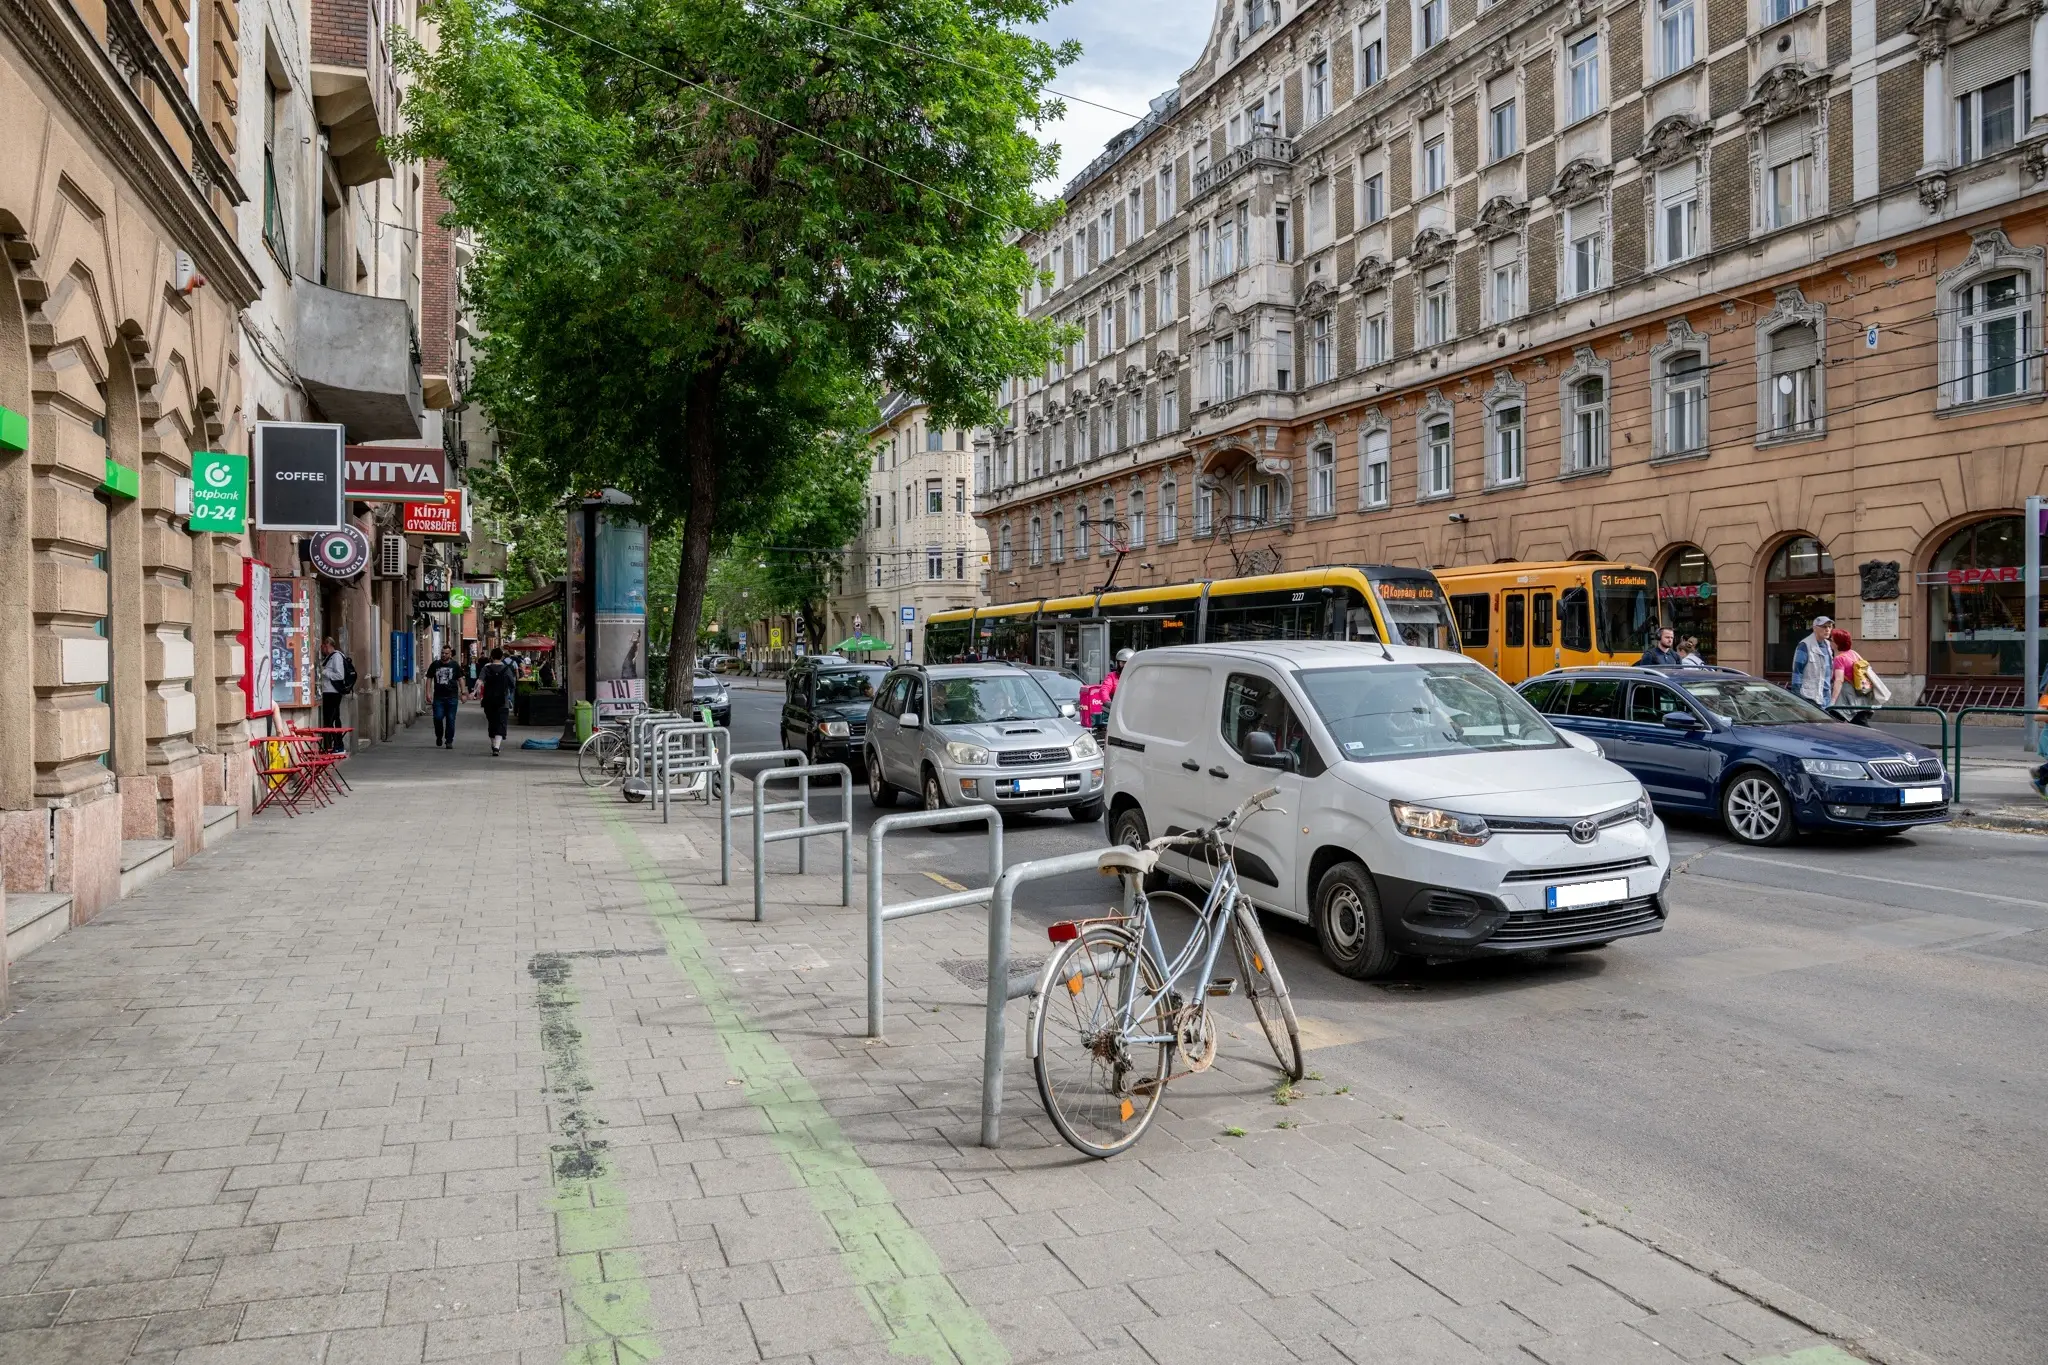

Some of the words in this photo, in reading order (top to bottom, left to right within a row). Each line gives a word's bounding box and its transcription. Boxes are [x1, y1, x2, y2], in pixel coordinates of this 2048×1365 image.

[275, 471, 324, 482] COFFEE
[345, 460, 439, 484] YITVA
[195, 489, 239, 501] otpbank
[196, 504, 237, 520] 0-24
[407, 519, 457, 532] GYORSBÜFÉ
[333, 545, 344, 556] T
[313, 555, 364, 575] DOHÁNYBOLT
[1601, 575, 1612, 586] 51
[1947, 566, 2017, 585] SPAR
[463, 587, 484, 597] TIKA
[1291, 592, 1305, 602] 2227
[1389, 585, 1416, 599] Koppány
[1418, 586, 1434, 598] utca
[419, 600, 448, 608] GYROS
